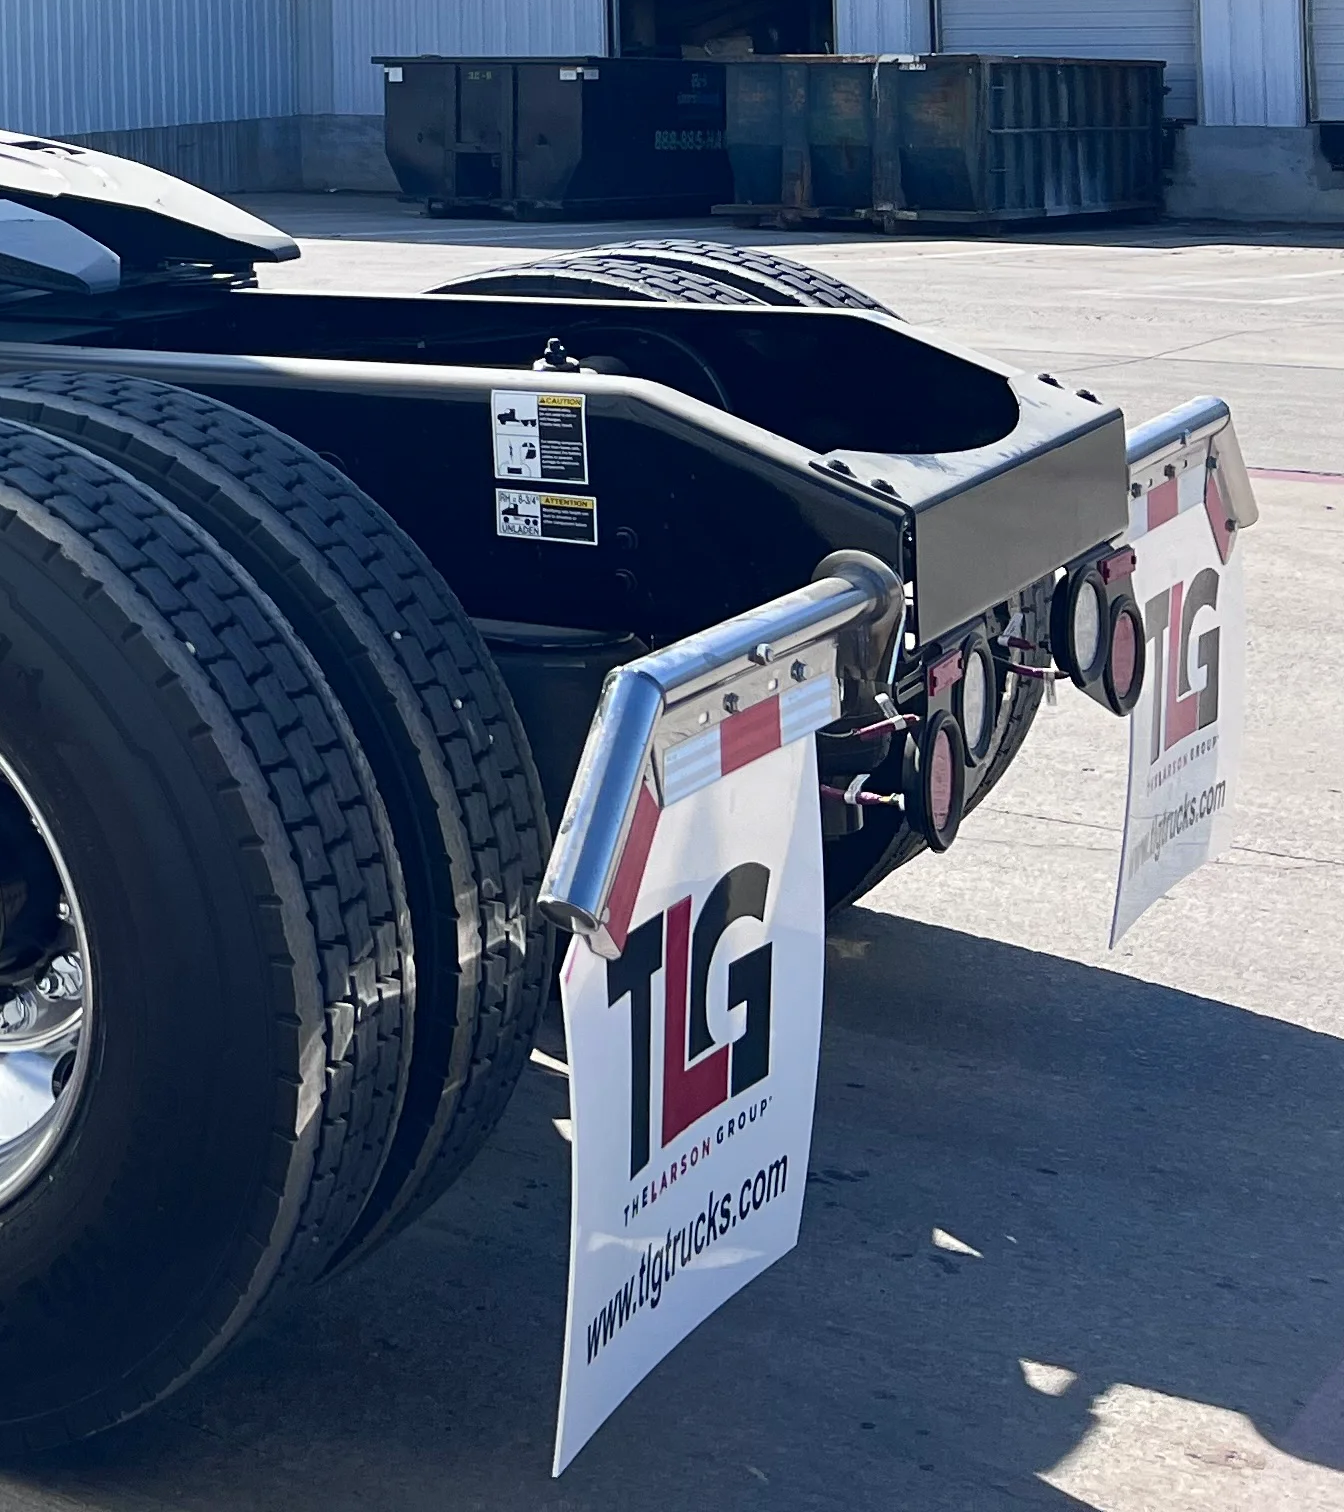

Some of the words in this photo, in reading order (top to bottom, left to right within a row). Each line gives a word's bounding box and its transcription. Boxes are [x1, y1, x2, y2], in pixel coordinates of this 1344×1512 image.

[545, 397, 582, 406] CAUTION
[544, 496, 588, 508] ATTENTION
[501, 524, 539, 535] UNLADEN
[1143, 567, 1220, 767] TLG
[607, 861, 774, 1180] TLG
[716, 1098, 768, 1144] GROUP
[586, 1154, 789, 1366] www.tlgtrucks.com
